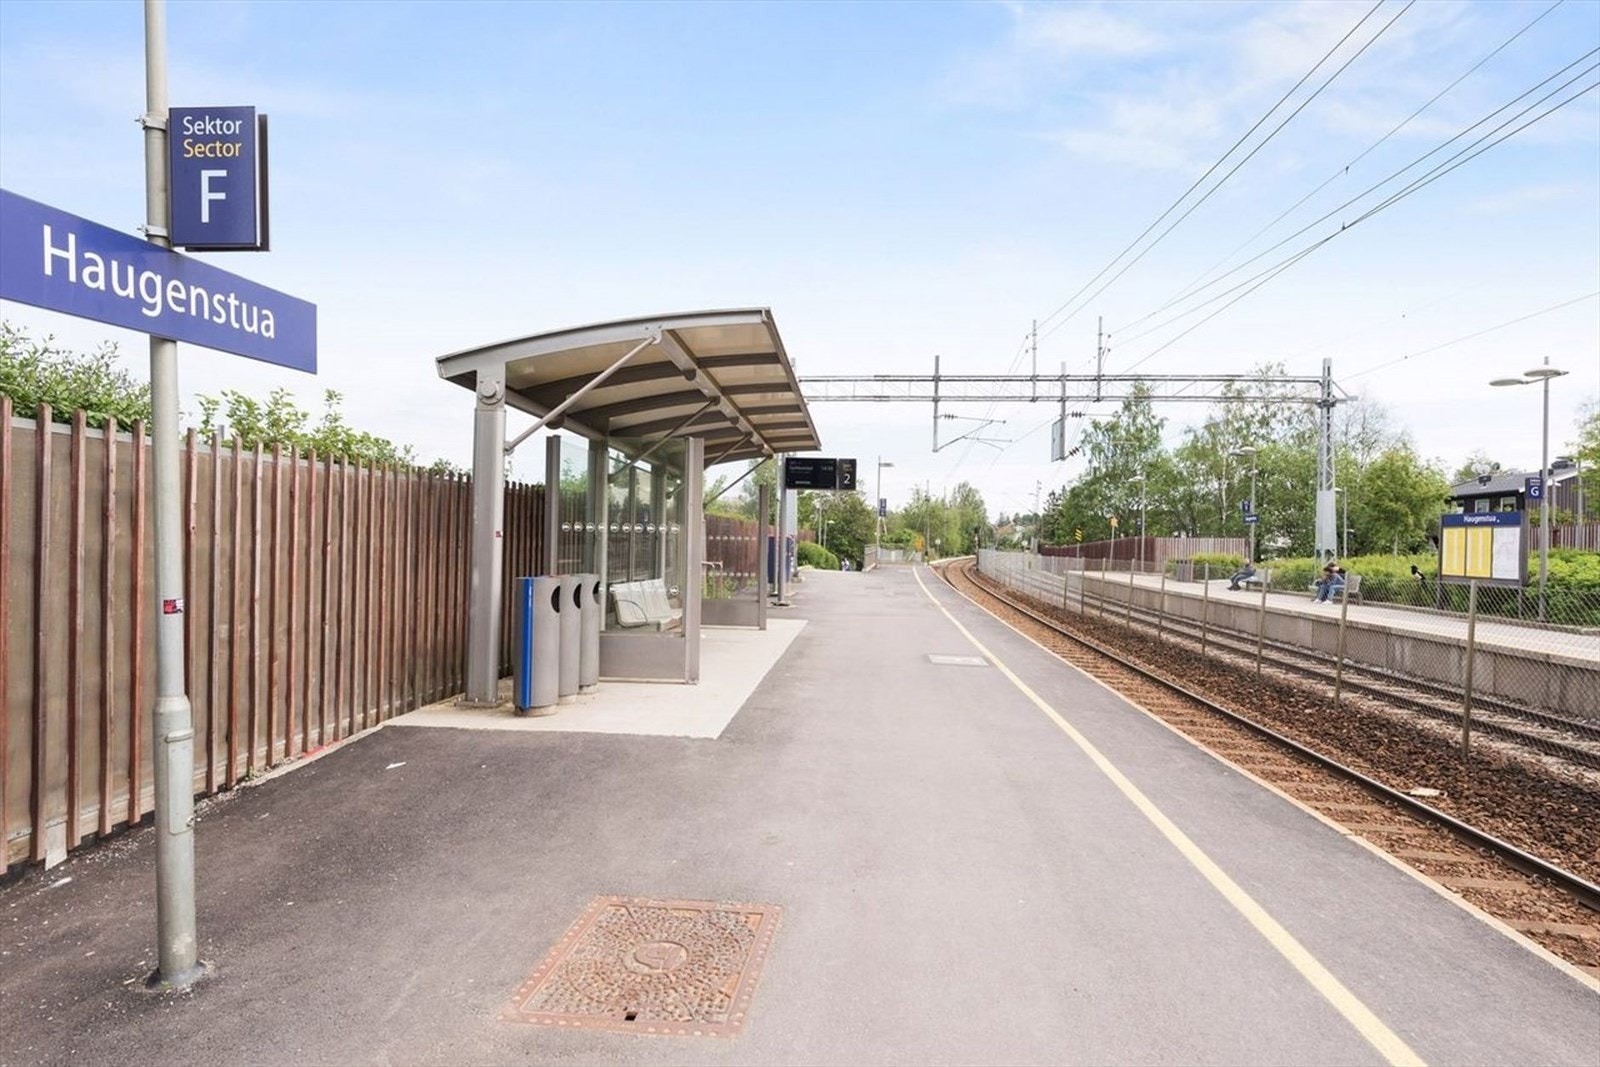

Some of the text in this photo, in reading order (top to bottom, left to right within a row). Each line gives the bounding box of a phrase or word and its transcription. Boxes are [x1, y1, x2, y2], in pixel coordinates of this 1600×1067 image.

[183, 115, 242, 135] Sektor
[183, 139, 242, 158] Sector
[200, 169, 228, 224] F
[43, 224, 275, 339] Haugenstua
[843, 473, 851, 484] 2
[1530, 486, 1540, 497] G
